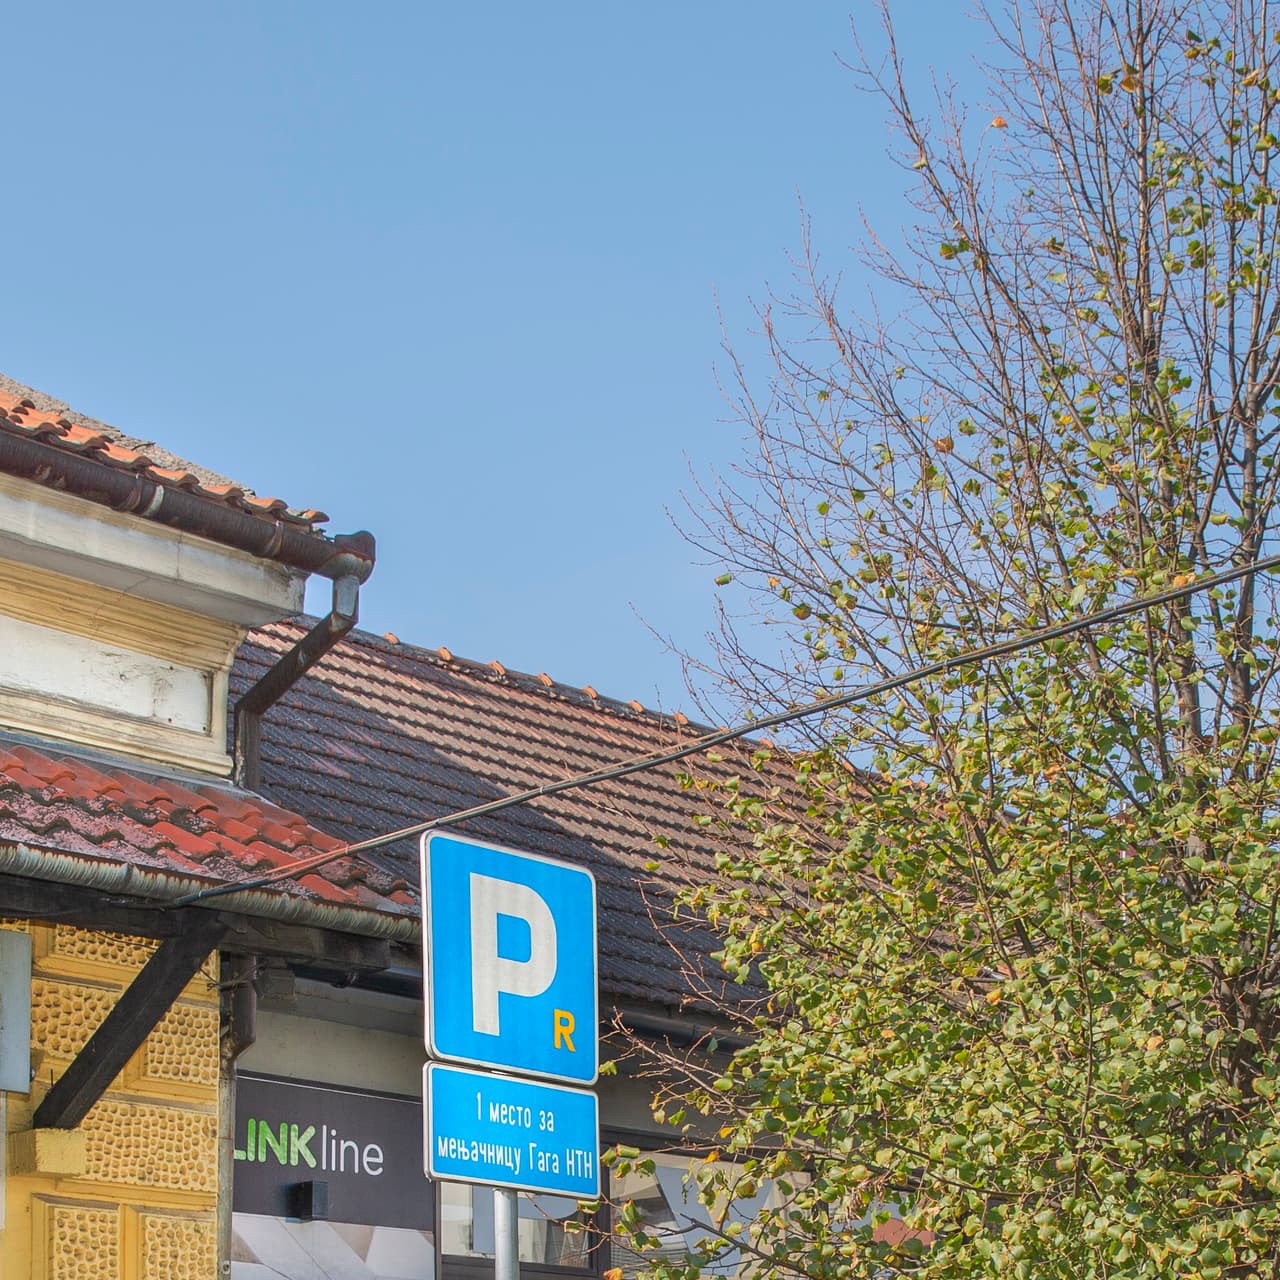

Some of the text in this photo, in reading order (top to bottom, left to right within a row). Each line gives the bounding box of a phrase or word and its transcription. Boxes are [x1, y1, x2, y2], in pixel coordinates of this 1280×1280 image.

[470, 872, 557, 1036] P
[553, 1008, 576, 1052] R
[476, 1091, 554, 1132] 1 место за
[438, 1135, 521, 1175] мењачницу
[529, 1142, 560, 1174] Гага
